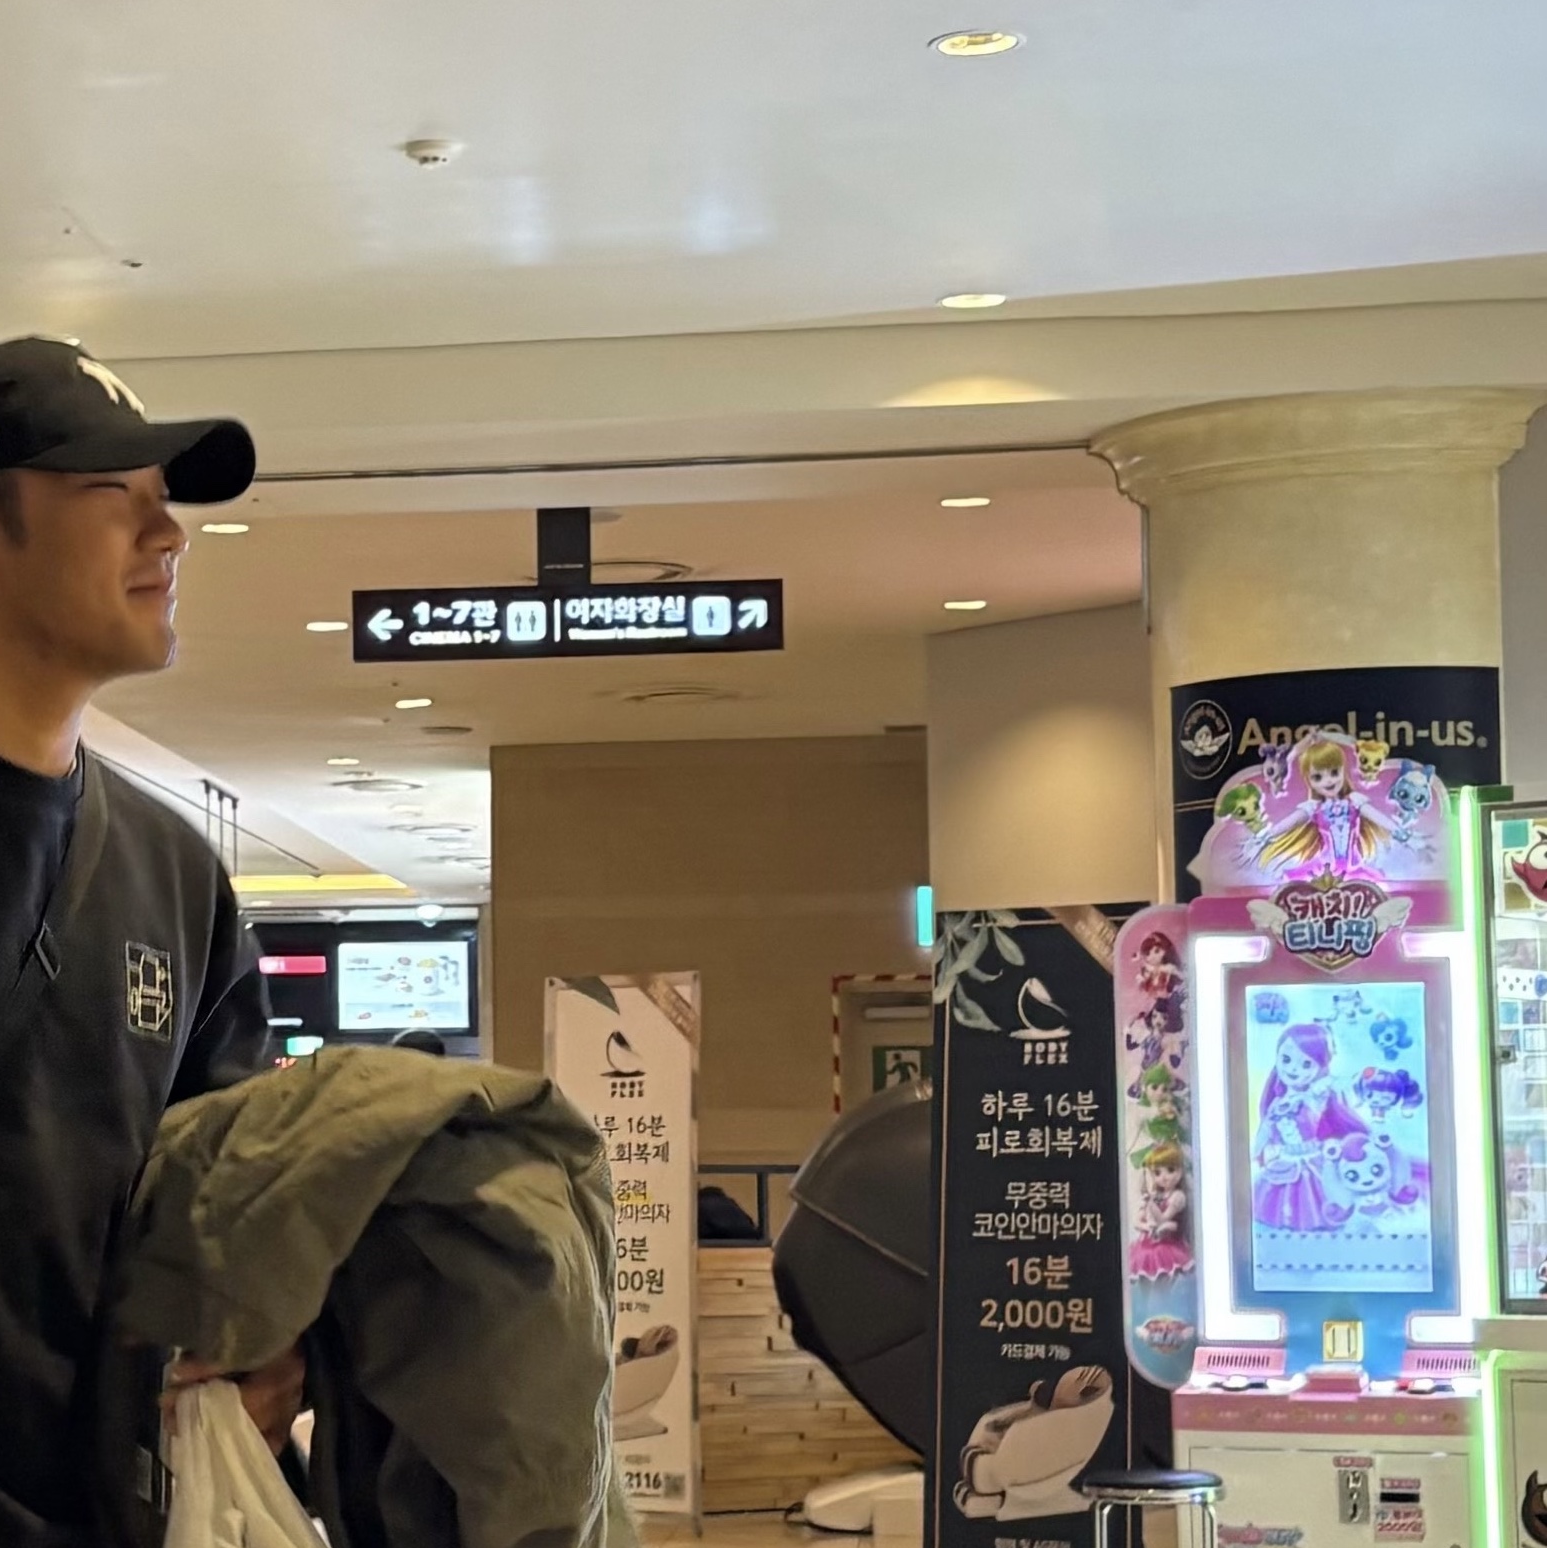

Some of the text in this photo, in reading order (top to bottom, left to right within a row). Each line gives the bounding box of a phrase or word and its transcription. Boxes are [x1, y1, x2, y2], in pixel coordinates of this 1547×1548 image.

[565, 595, 686, 625] 여자화장실
[1284, 918, 1377, 957] 티니핑
[981, 1089, 1100, 1122] 하루 16분
[594, 1114, 666, 1138] 루 16분
[609, 1141, 669, 1164] 회복제
[975, 1126, 1103, 1158] 피로회복제
[1005, 1181, 1072, 1210] 무중력
[972, 1211, 1103, 1240] 코인안마의자
[616, 1236, 649, 1261] 6분
[1006, 1255, 1073, 1290] 16분
[979, 1298, 1093, 1334] 2,000원
